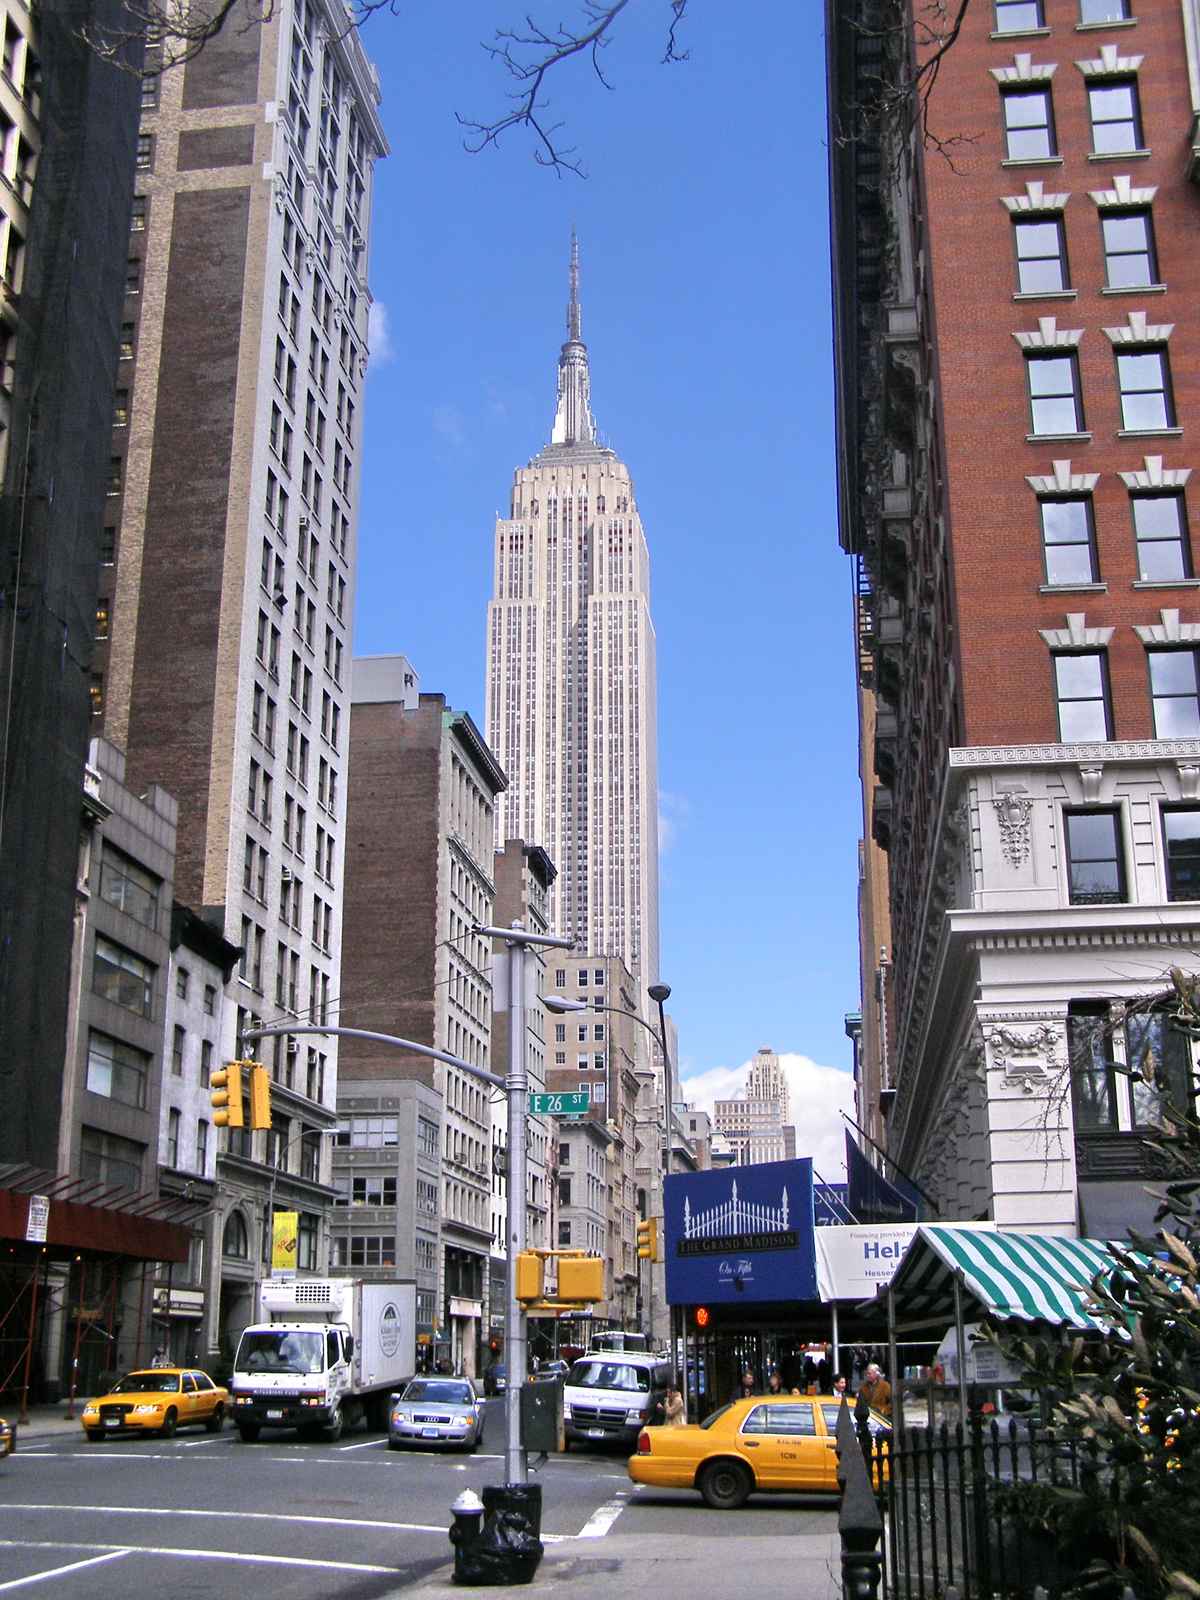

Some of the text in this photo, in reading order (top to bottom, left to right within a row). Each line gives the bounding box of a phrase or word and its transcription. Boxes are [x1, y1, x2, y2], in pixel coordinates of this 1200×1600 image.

[534, 1094, 582, 1112] E 26 ST
[681, 1234, 795, 1253] THE GRAND MADISON
